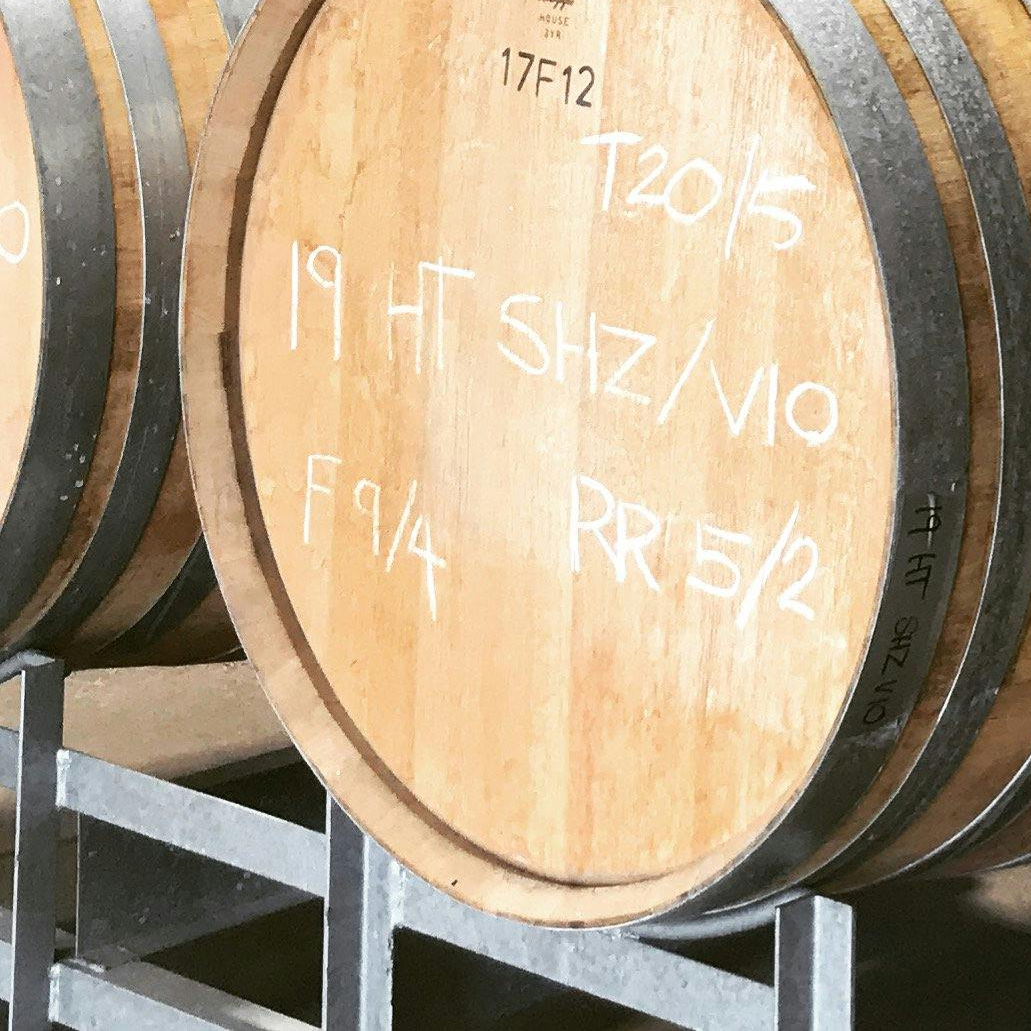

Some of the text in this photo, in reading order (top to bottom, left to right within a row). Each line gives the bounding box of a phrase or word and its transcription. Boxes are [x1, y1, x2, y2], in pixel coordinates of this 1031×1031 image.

[502, 47, 596, 108] 17F12
[580, 131, 816, 259] T20/5
[290, 240, 342, 361] 19
[387, 256, 476, 373] HT
[568, 474, 823, 629] RR 5/2
